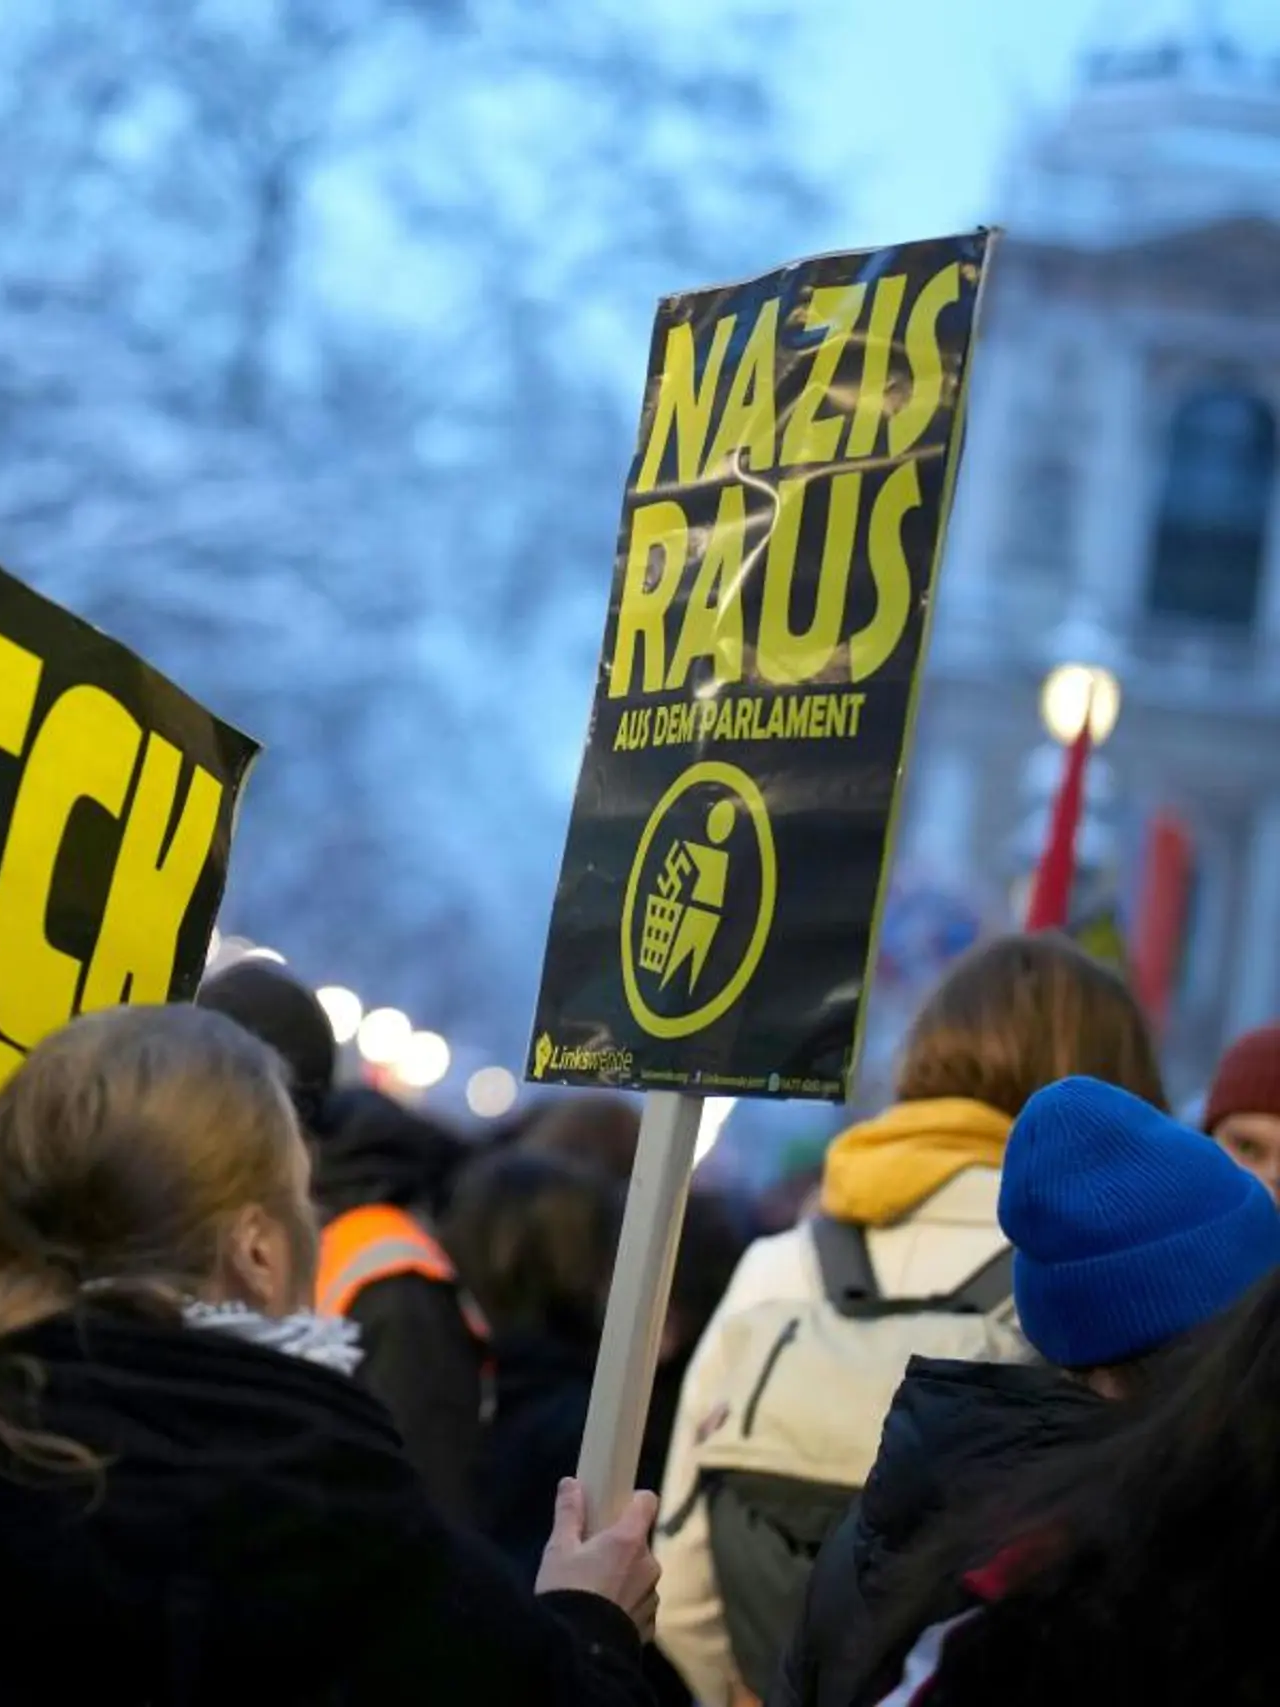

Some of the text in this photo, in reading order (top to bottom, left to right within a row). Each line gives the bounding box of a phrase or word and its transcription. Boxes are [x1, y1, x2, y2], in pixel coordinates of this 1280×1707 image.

[635, 262, 960, 493] NAZIS
[608, 460, 922, 698] RAUS
[613, 693, 866, 752] AUS DEM PARLAMENT
